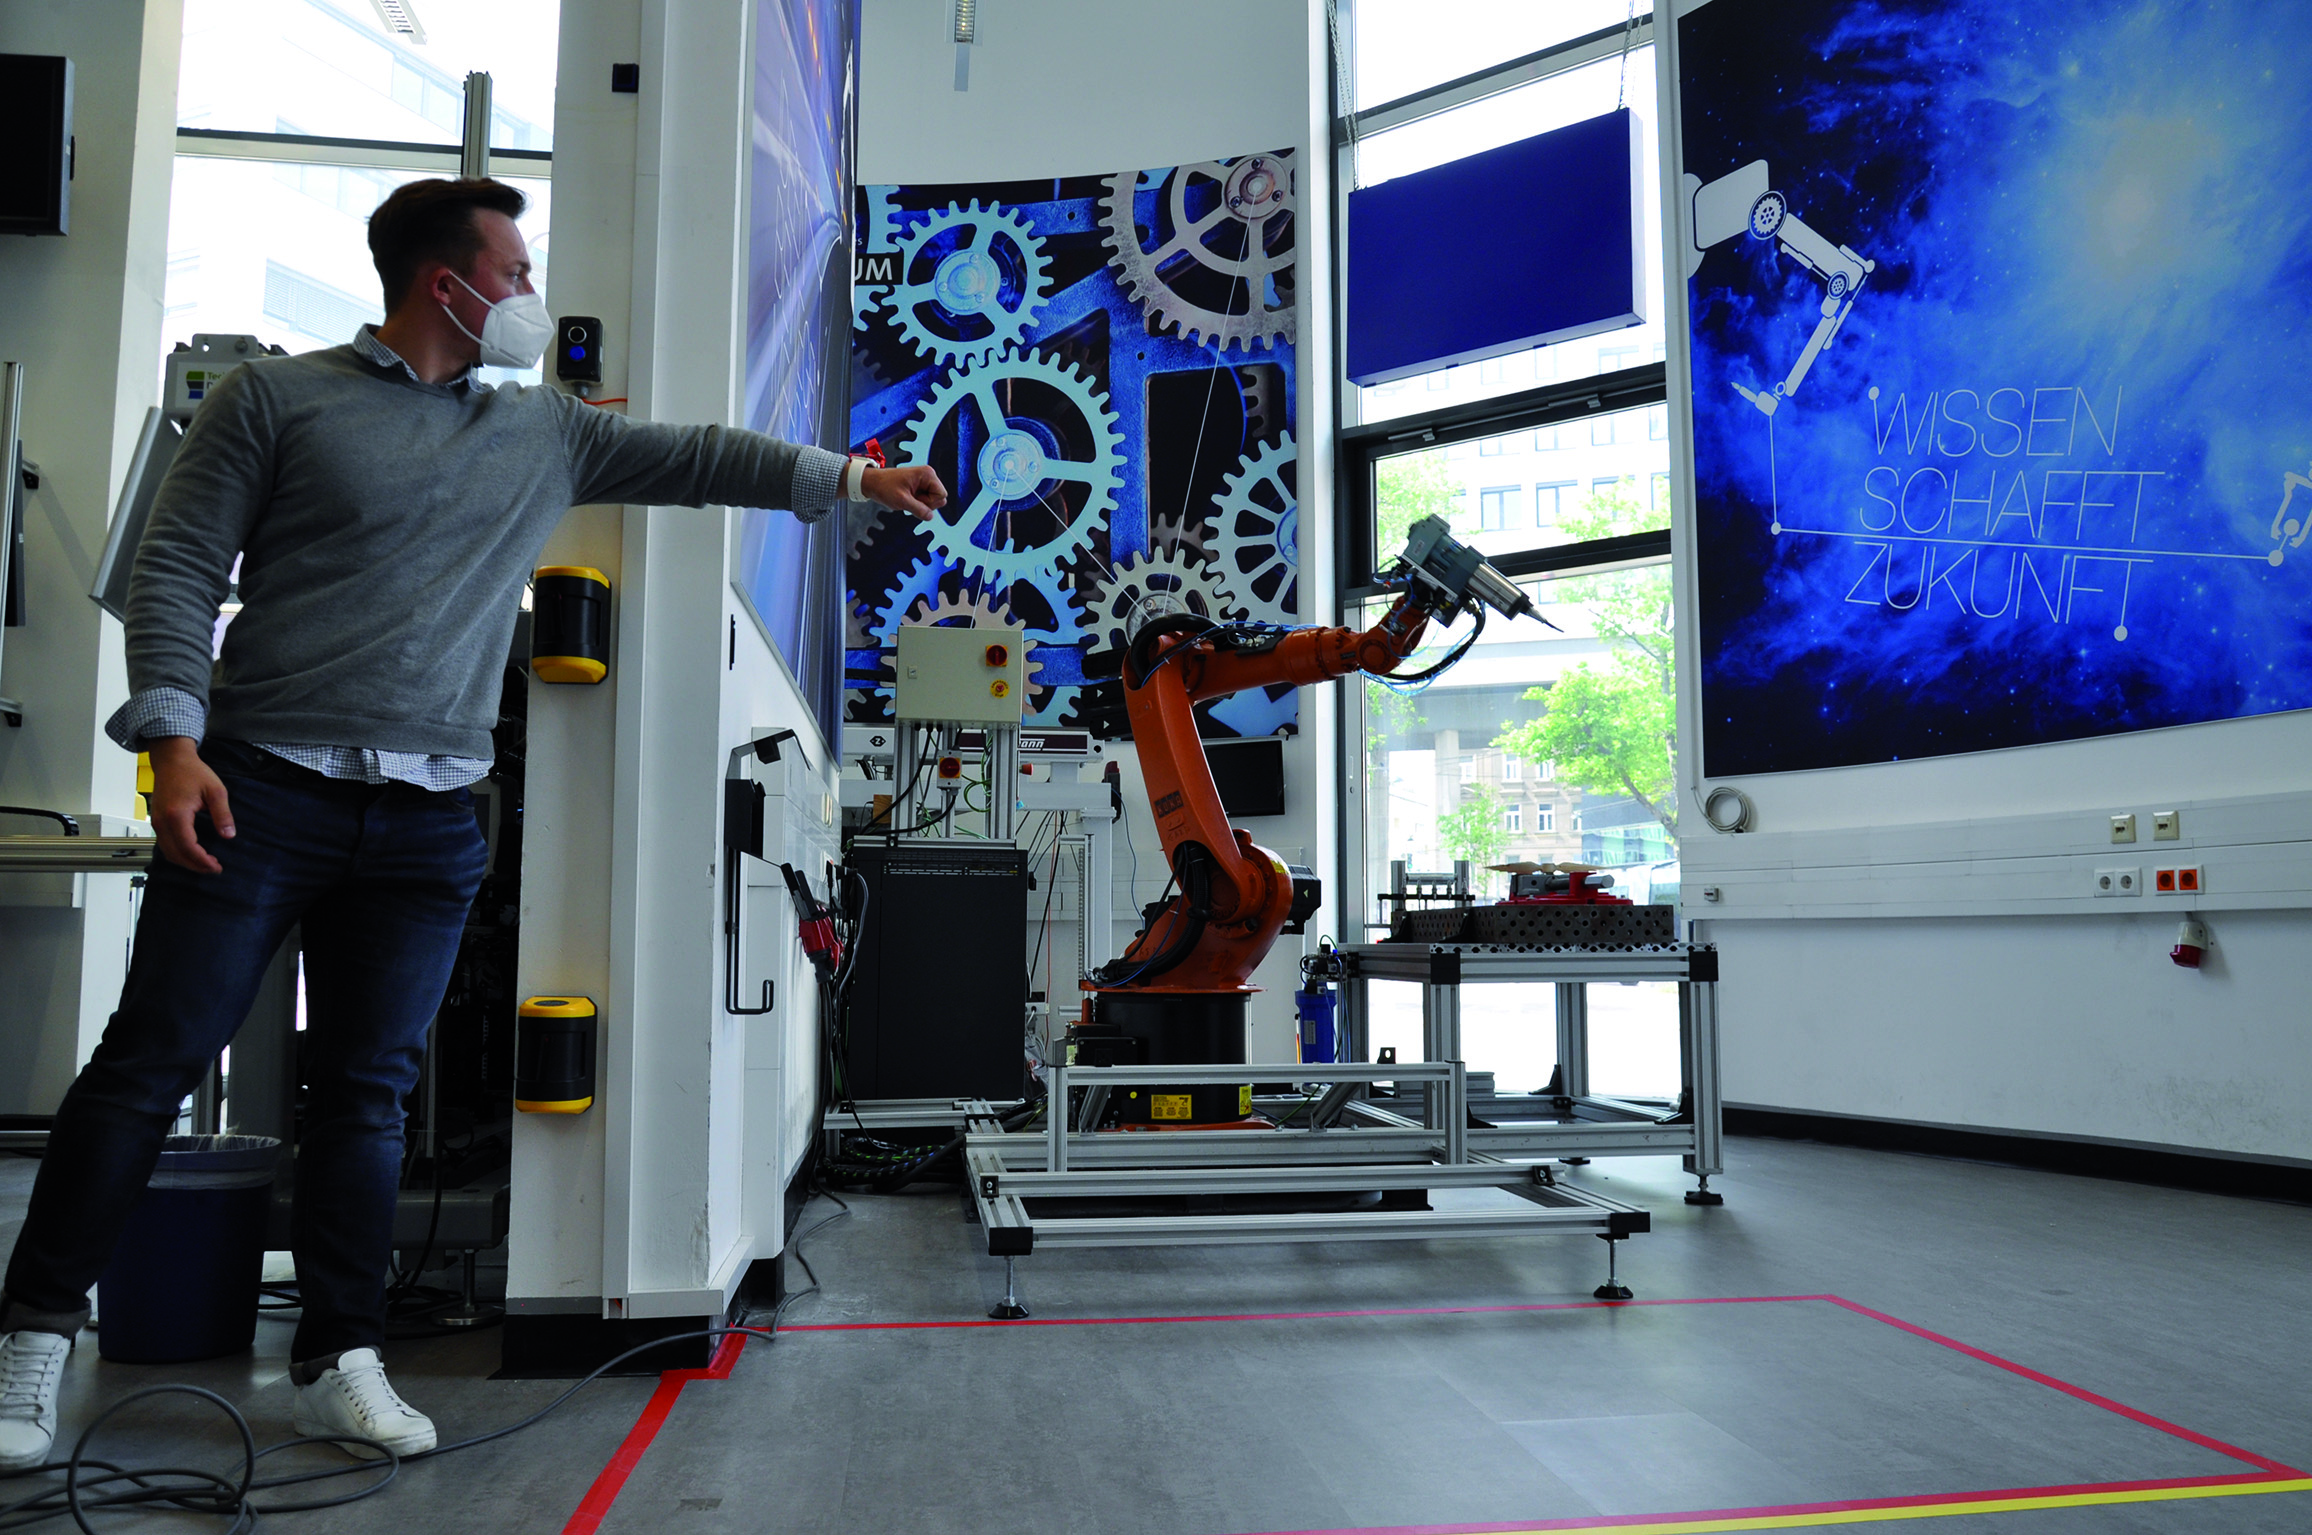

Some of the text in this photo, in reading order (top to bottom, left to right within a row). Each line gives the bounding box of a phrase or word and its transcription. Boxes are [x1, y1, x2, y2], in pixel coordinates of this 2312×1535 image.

[1868, 385, 2122, 457] WISSEN
[1860, 466, 2165, 543] SCHAFFT
[1845, 541, 2154, 630] ZUKUNFT
